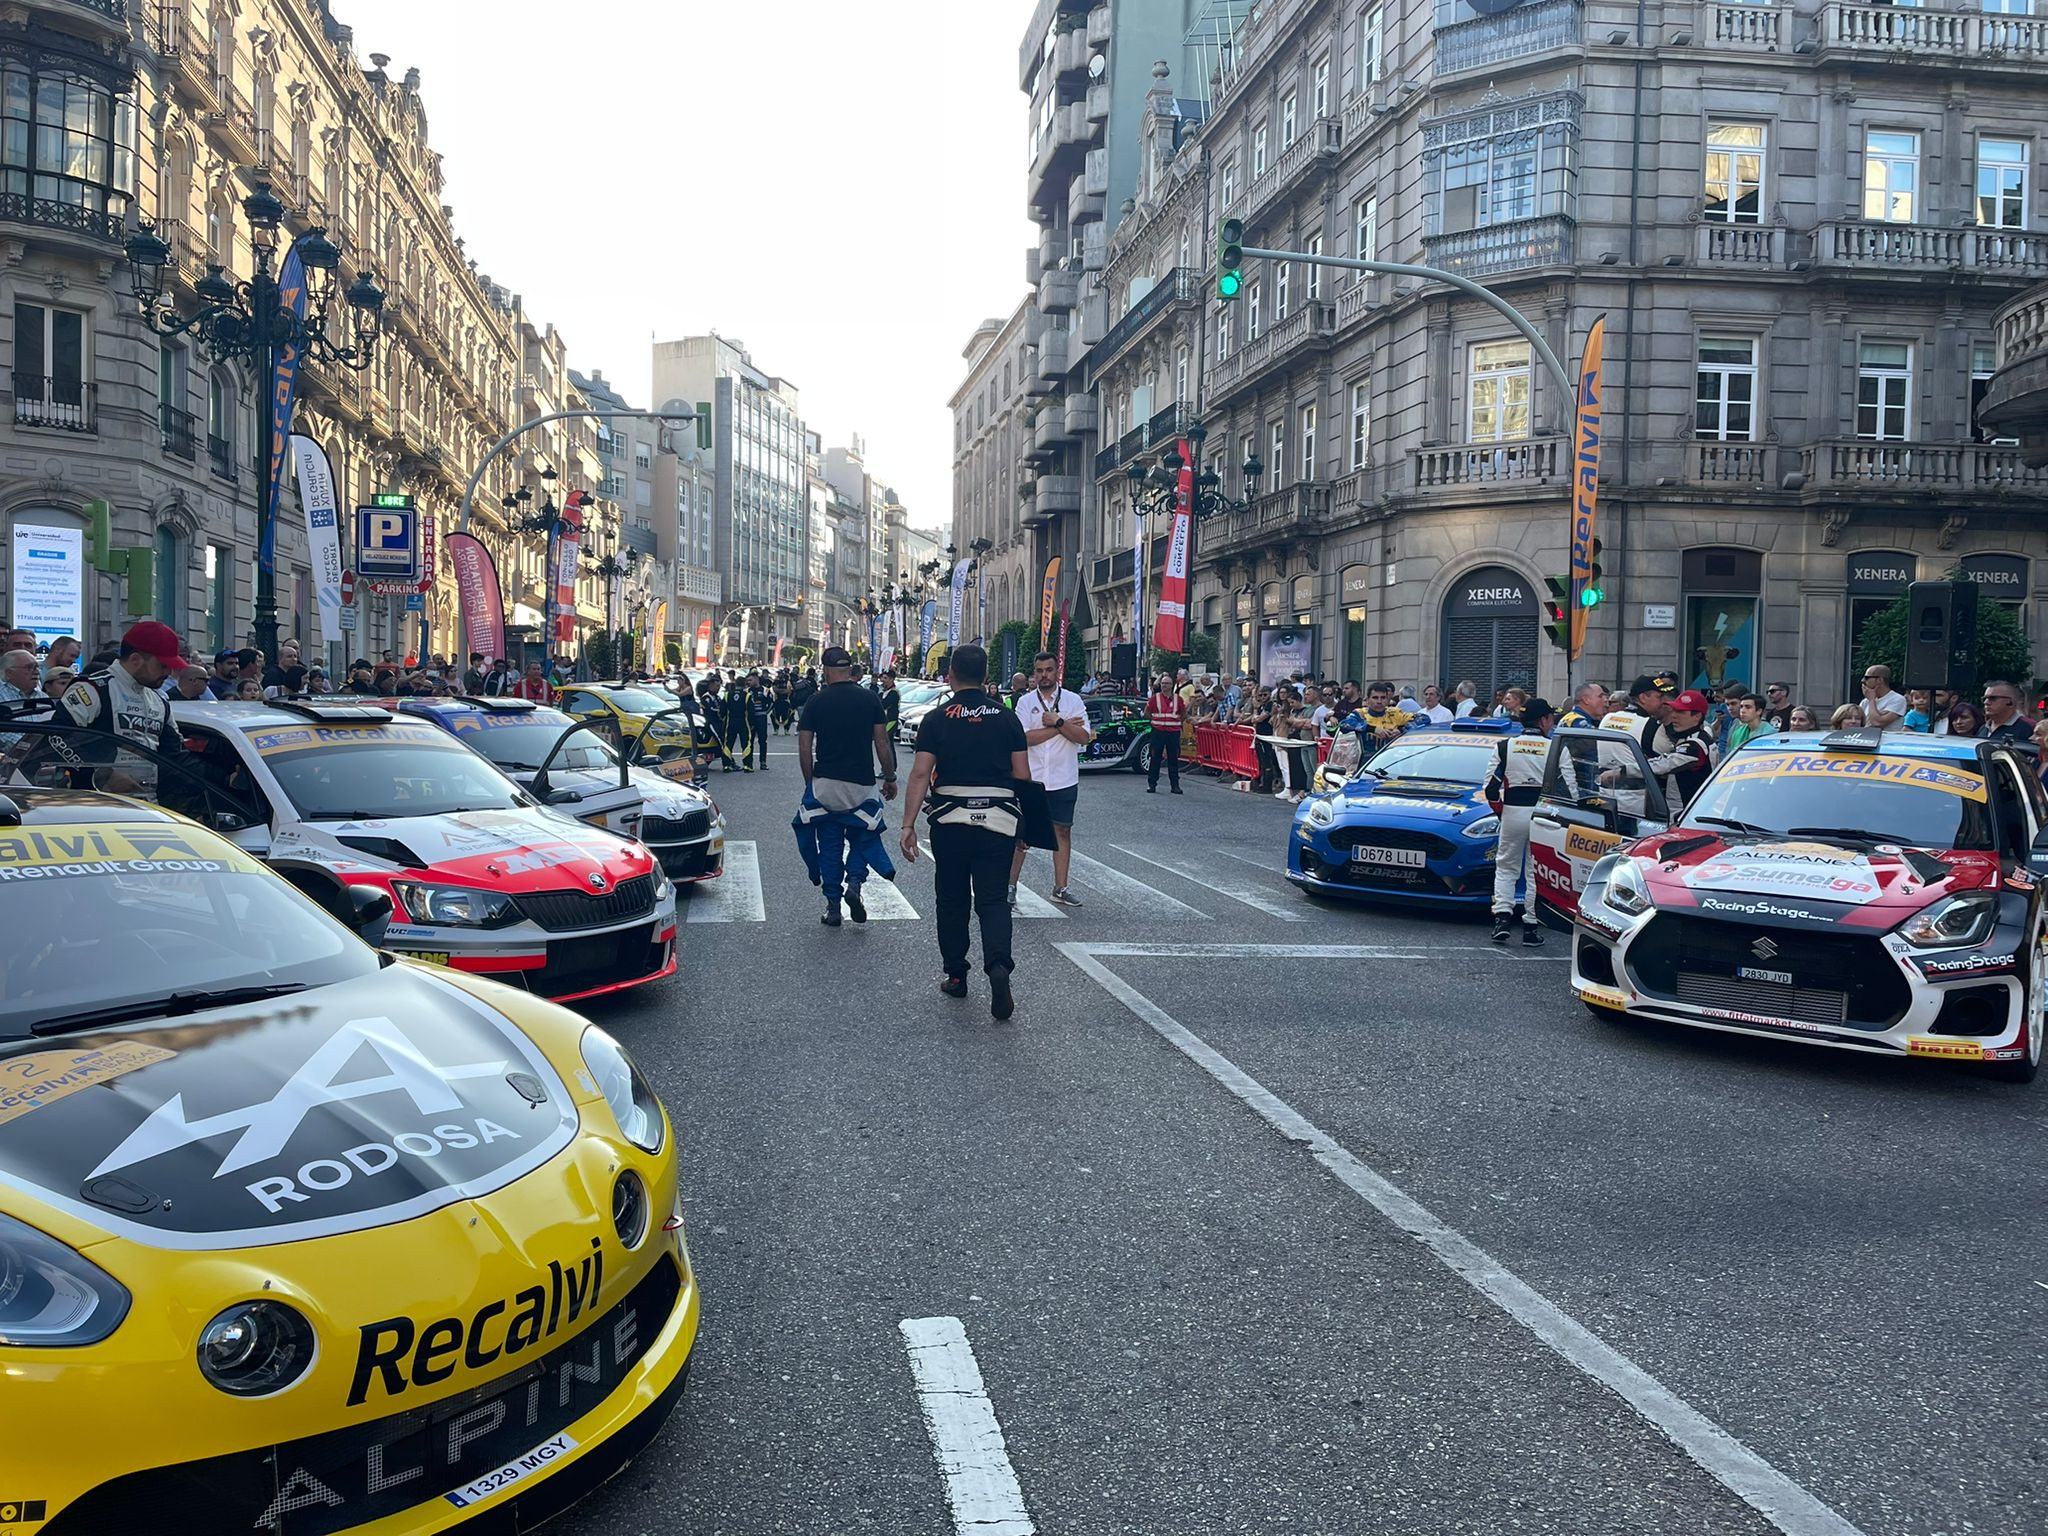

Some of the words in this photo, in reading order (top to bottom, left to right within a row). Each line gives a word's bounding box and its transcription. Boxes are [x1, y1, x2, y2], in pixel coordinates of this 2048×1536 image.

[378, 495, 405, 506] LIBRE
[1572, 413, 1600, 570] Recalvi
[370, 514, 403, 548] P
[424, 517, 434, 582] ENTRADA
[1854, 567, 1907, 581] XENERA
[1967, 571, 2019, 584] XENERA
[376, 583, 420, 594] PARKING
[1467, 587, 1522, 600] XENERA
[950, 587, 962, 642] Celtamotor
[1785, 756, 1910, 778] Recalvi
[1361, 848, 1393, 862] 0678
[1397, 851, 1422, 866] LLL
[1, 861, 127, 880] Renault
[128, 858, 221, 872] Group
[1701, 898, 1809, 920] RacingStage
[1923, 953, 2016, 972] RacingStage
[1744, 969, 1769, 979] 2830
[1770, 972, 1789, 983] JYD
[1701, 1007, 1818, 1032] www.fitfatmarket.com
[1910, 1040, 1979, 1055] PIRELLI
[6, 1063, 49, 1078] 2
[246, 1117, 522, 1214] RODOSA
[346, 1236, 604, 1407] Recalvi
[253, 1307, 638, 1529] ALPINE
[466, 1467, 519, 1498] 1329
[518, 1436, 568, 1471] MGY
